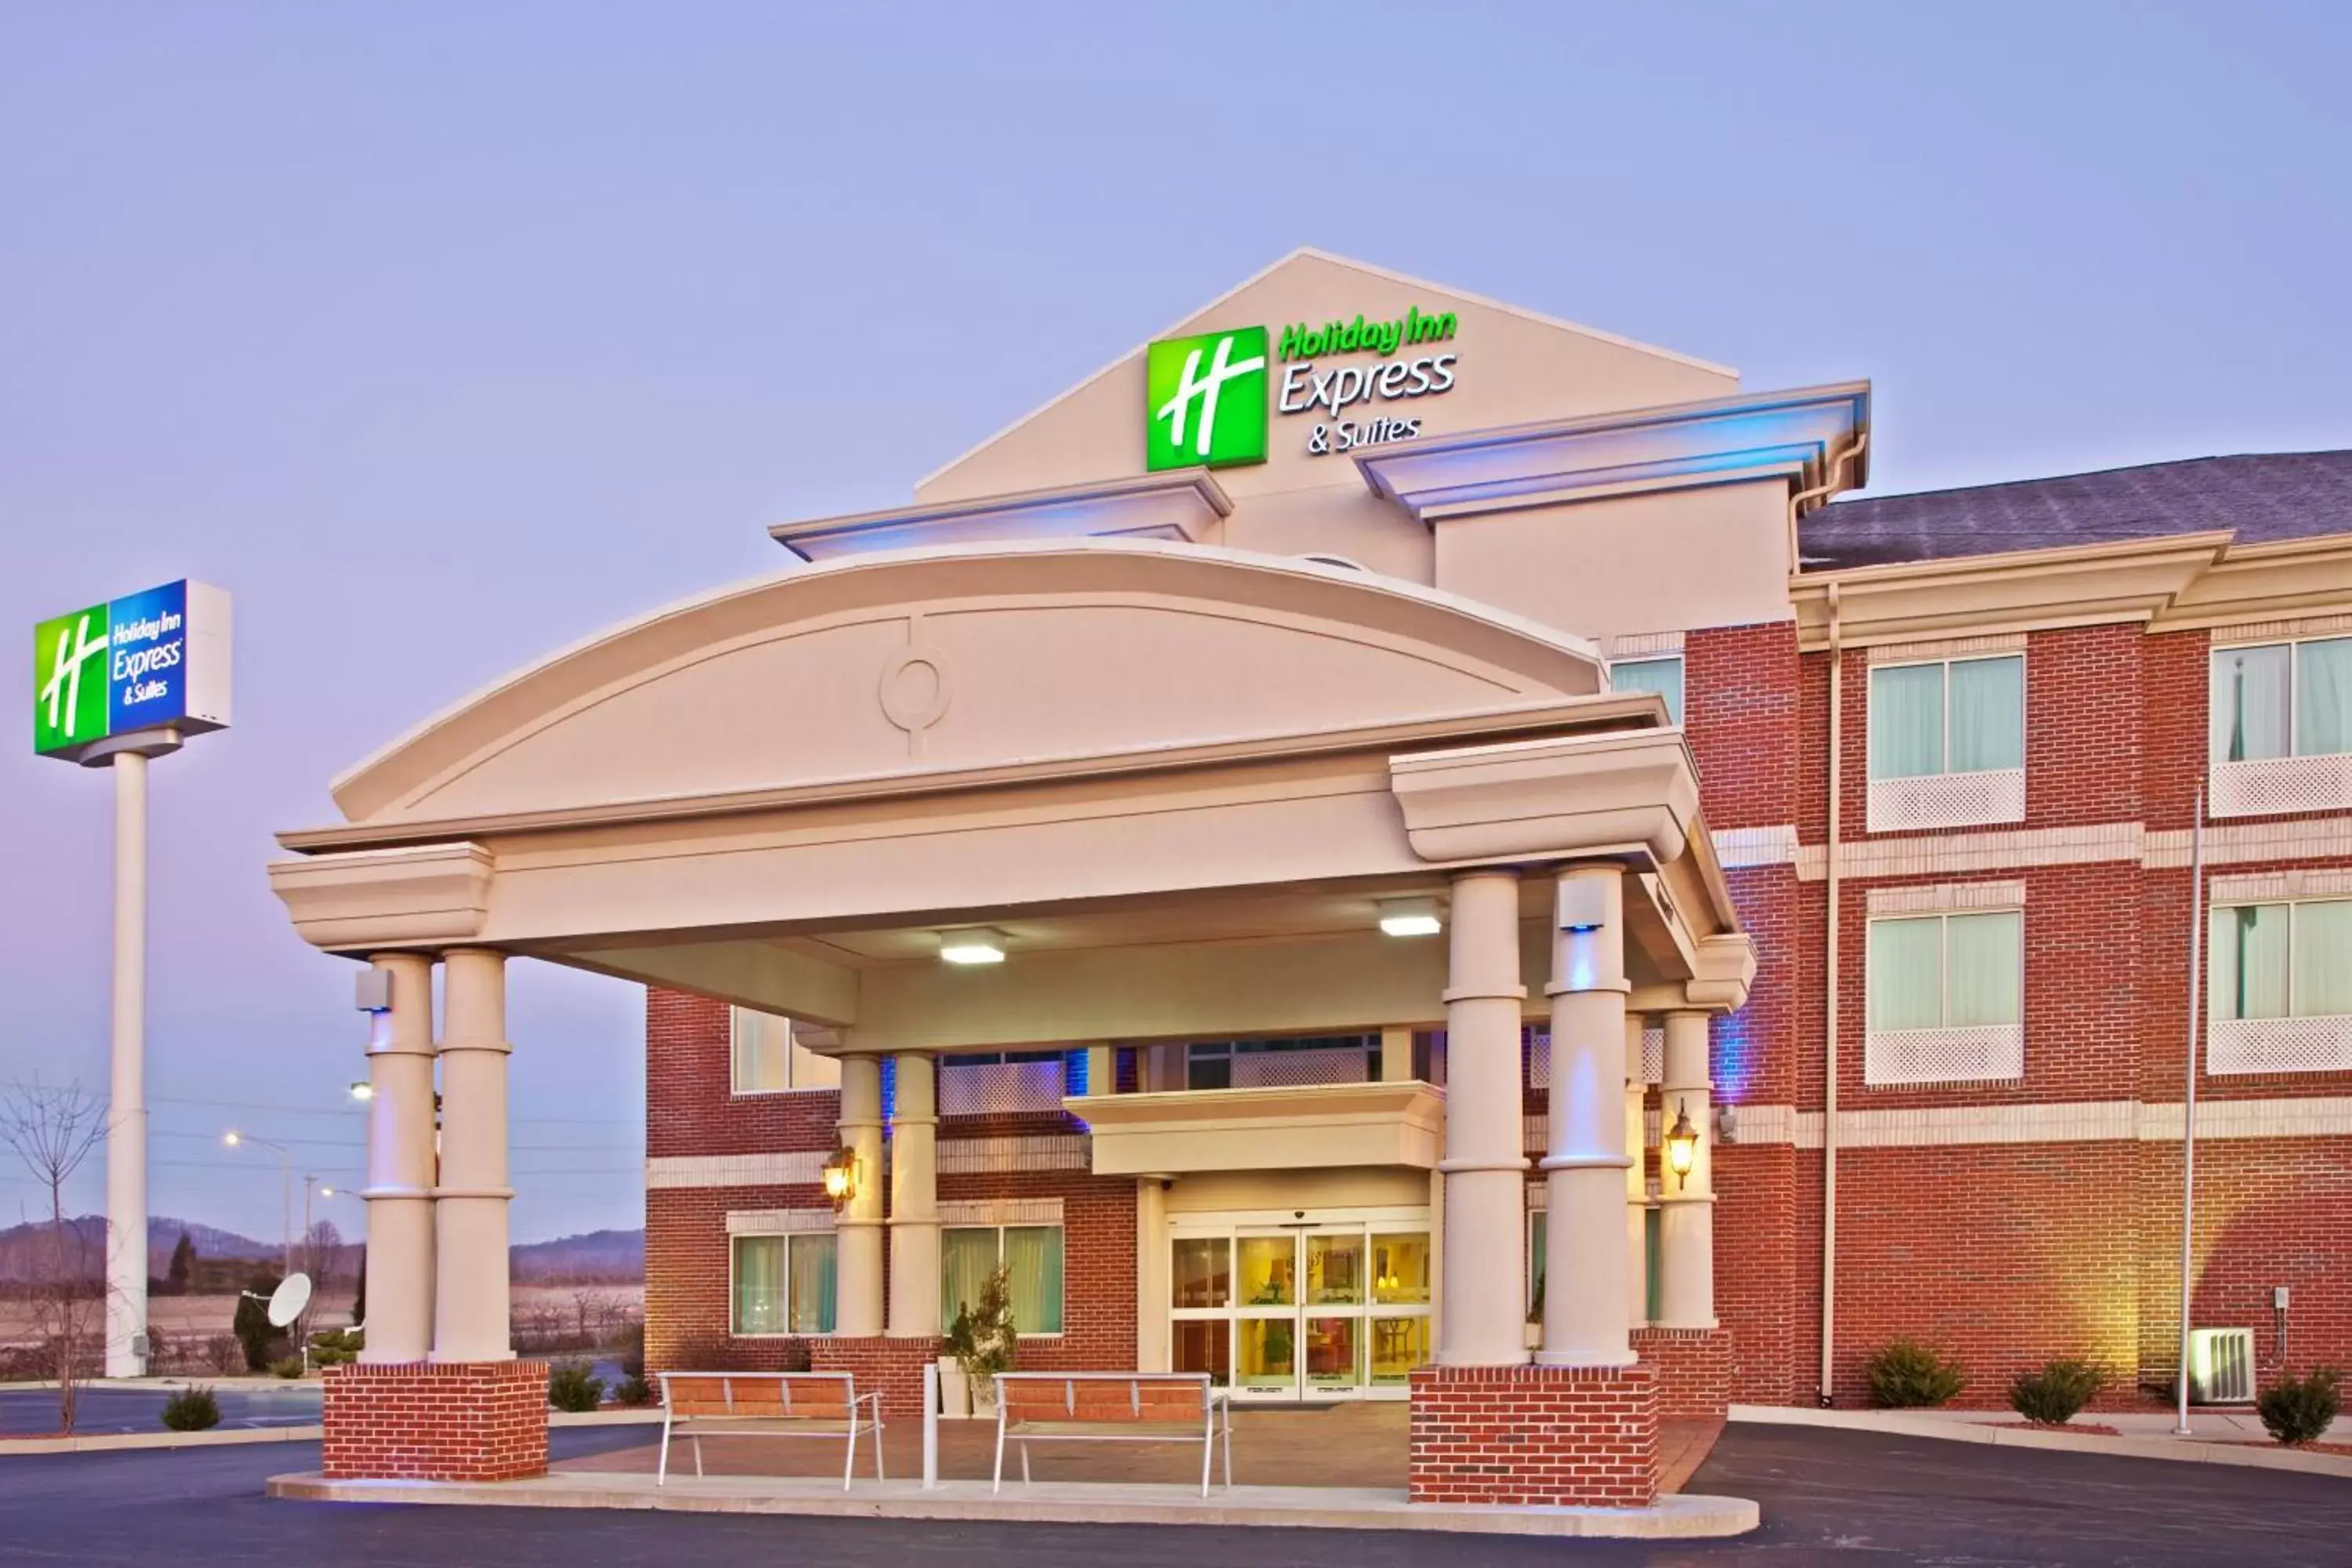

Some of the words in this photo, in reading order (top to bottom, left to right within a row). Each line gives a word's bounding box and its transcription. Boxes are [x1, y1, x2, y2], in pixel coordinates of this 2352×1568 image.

[1279, 314, 1402, 362] Holiday
[1406, 305, 1457, 343] Inn
[1279, 354, 1457, 419] Express
[1308, 423, 1330, 455] &
[1337, 416, 1421, 452] Suites
[114, 617, 161, 646] Holiday
[162, 611, 181, 633] Inn
[113, 641, 181, 684] Express
[133, 681, 168, 702] Suites
